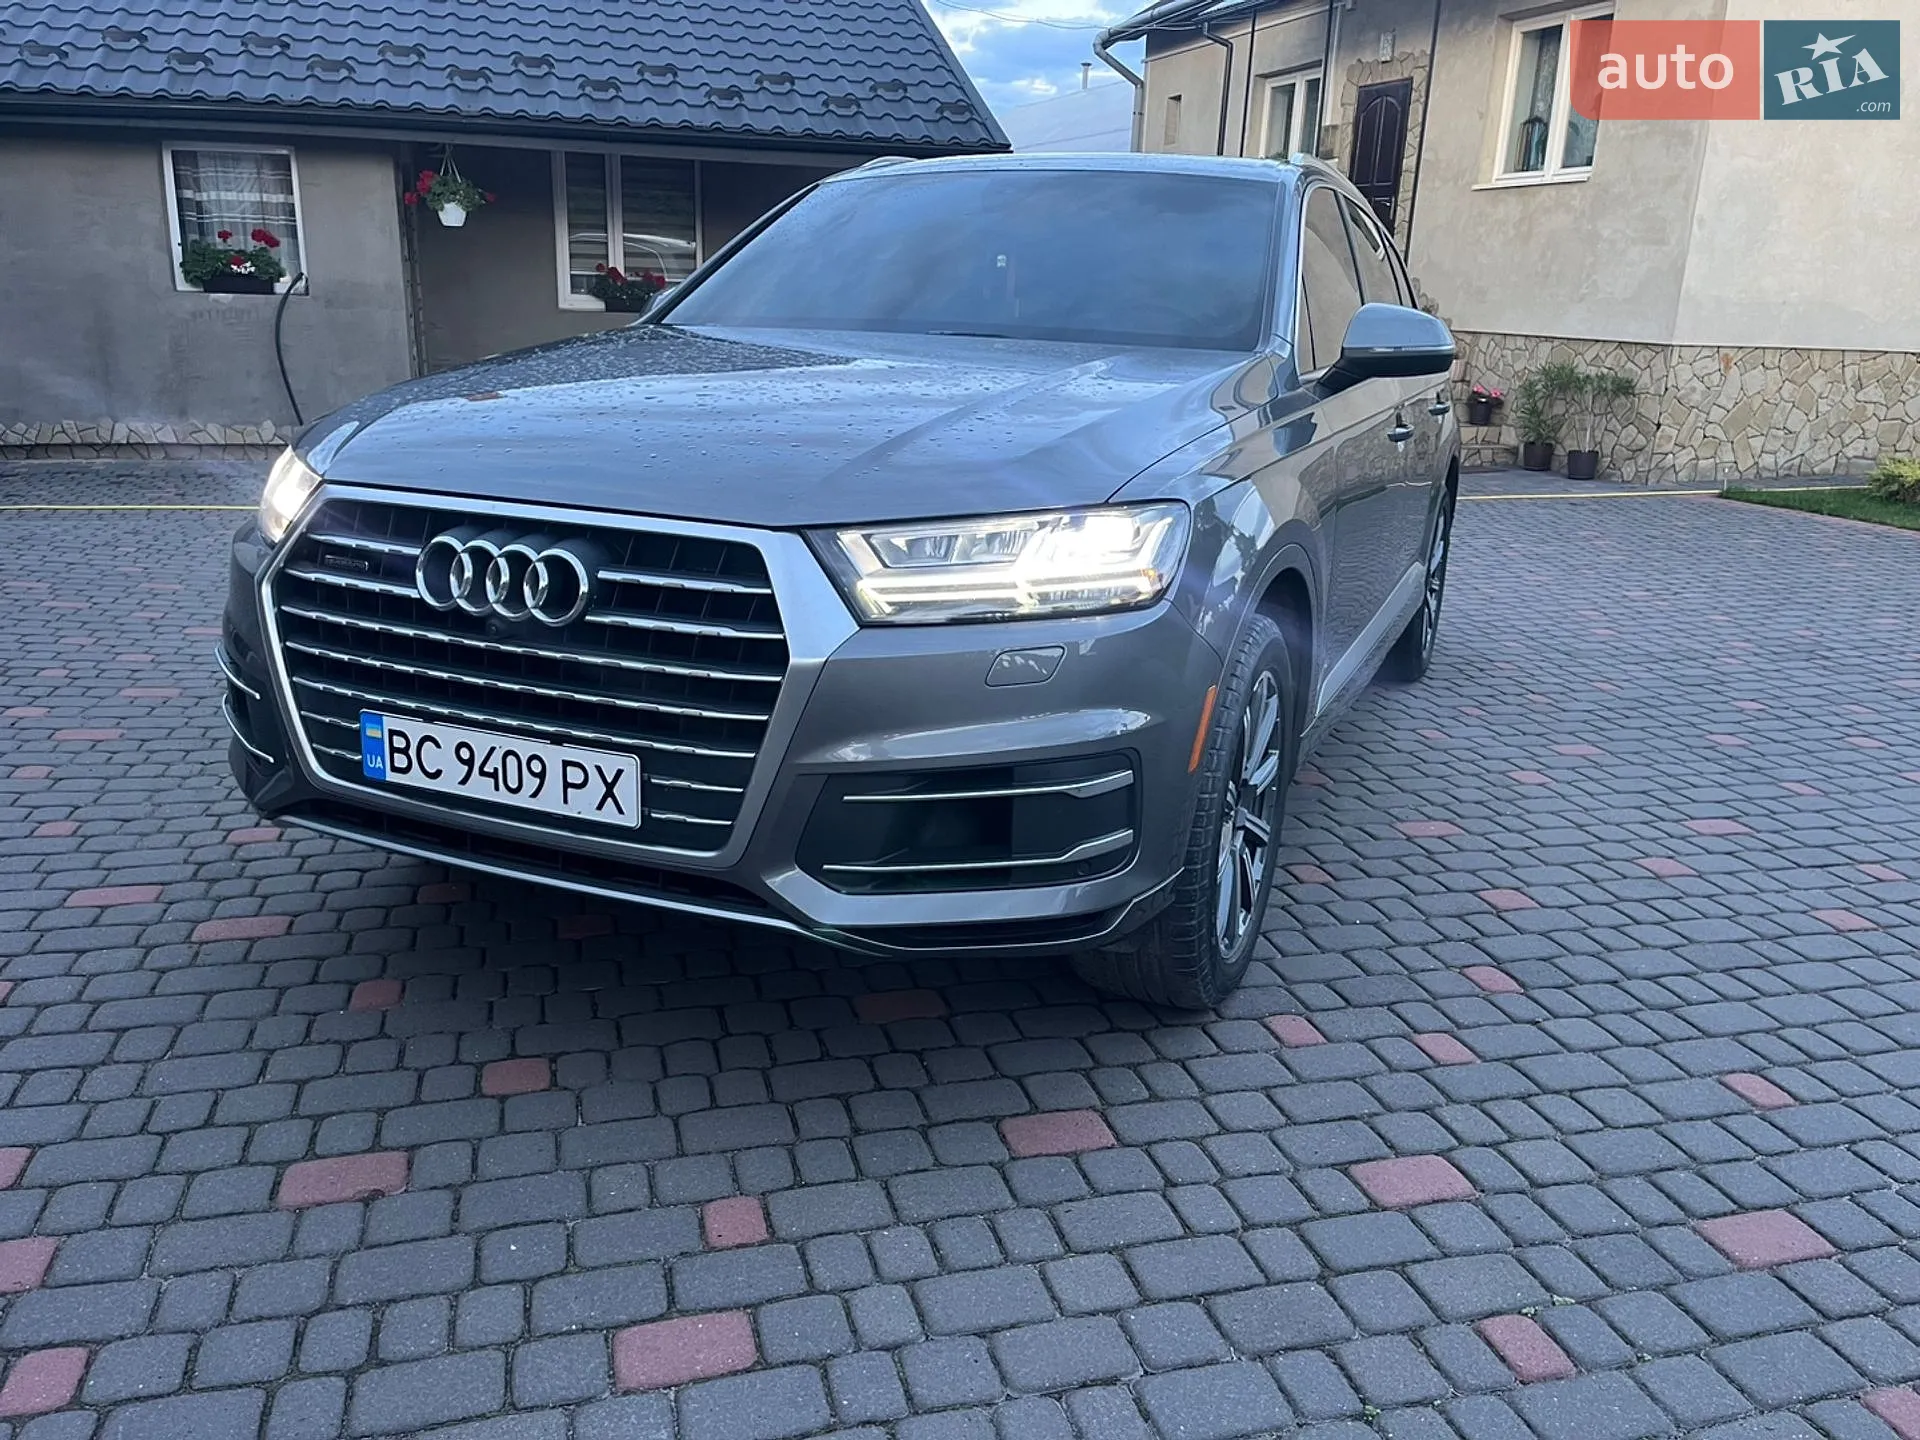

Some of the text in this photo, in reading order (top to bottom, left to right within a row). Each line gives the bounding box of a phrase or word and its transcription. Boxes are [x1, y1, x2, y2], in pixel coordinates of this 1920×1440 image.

[366, 753, 384, 770] UA
[387, 728, 625, 815] BC 9409 PX
